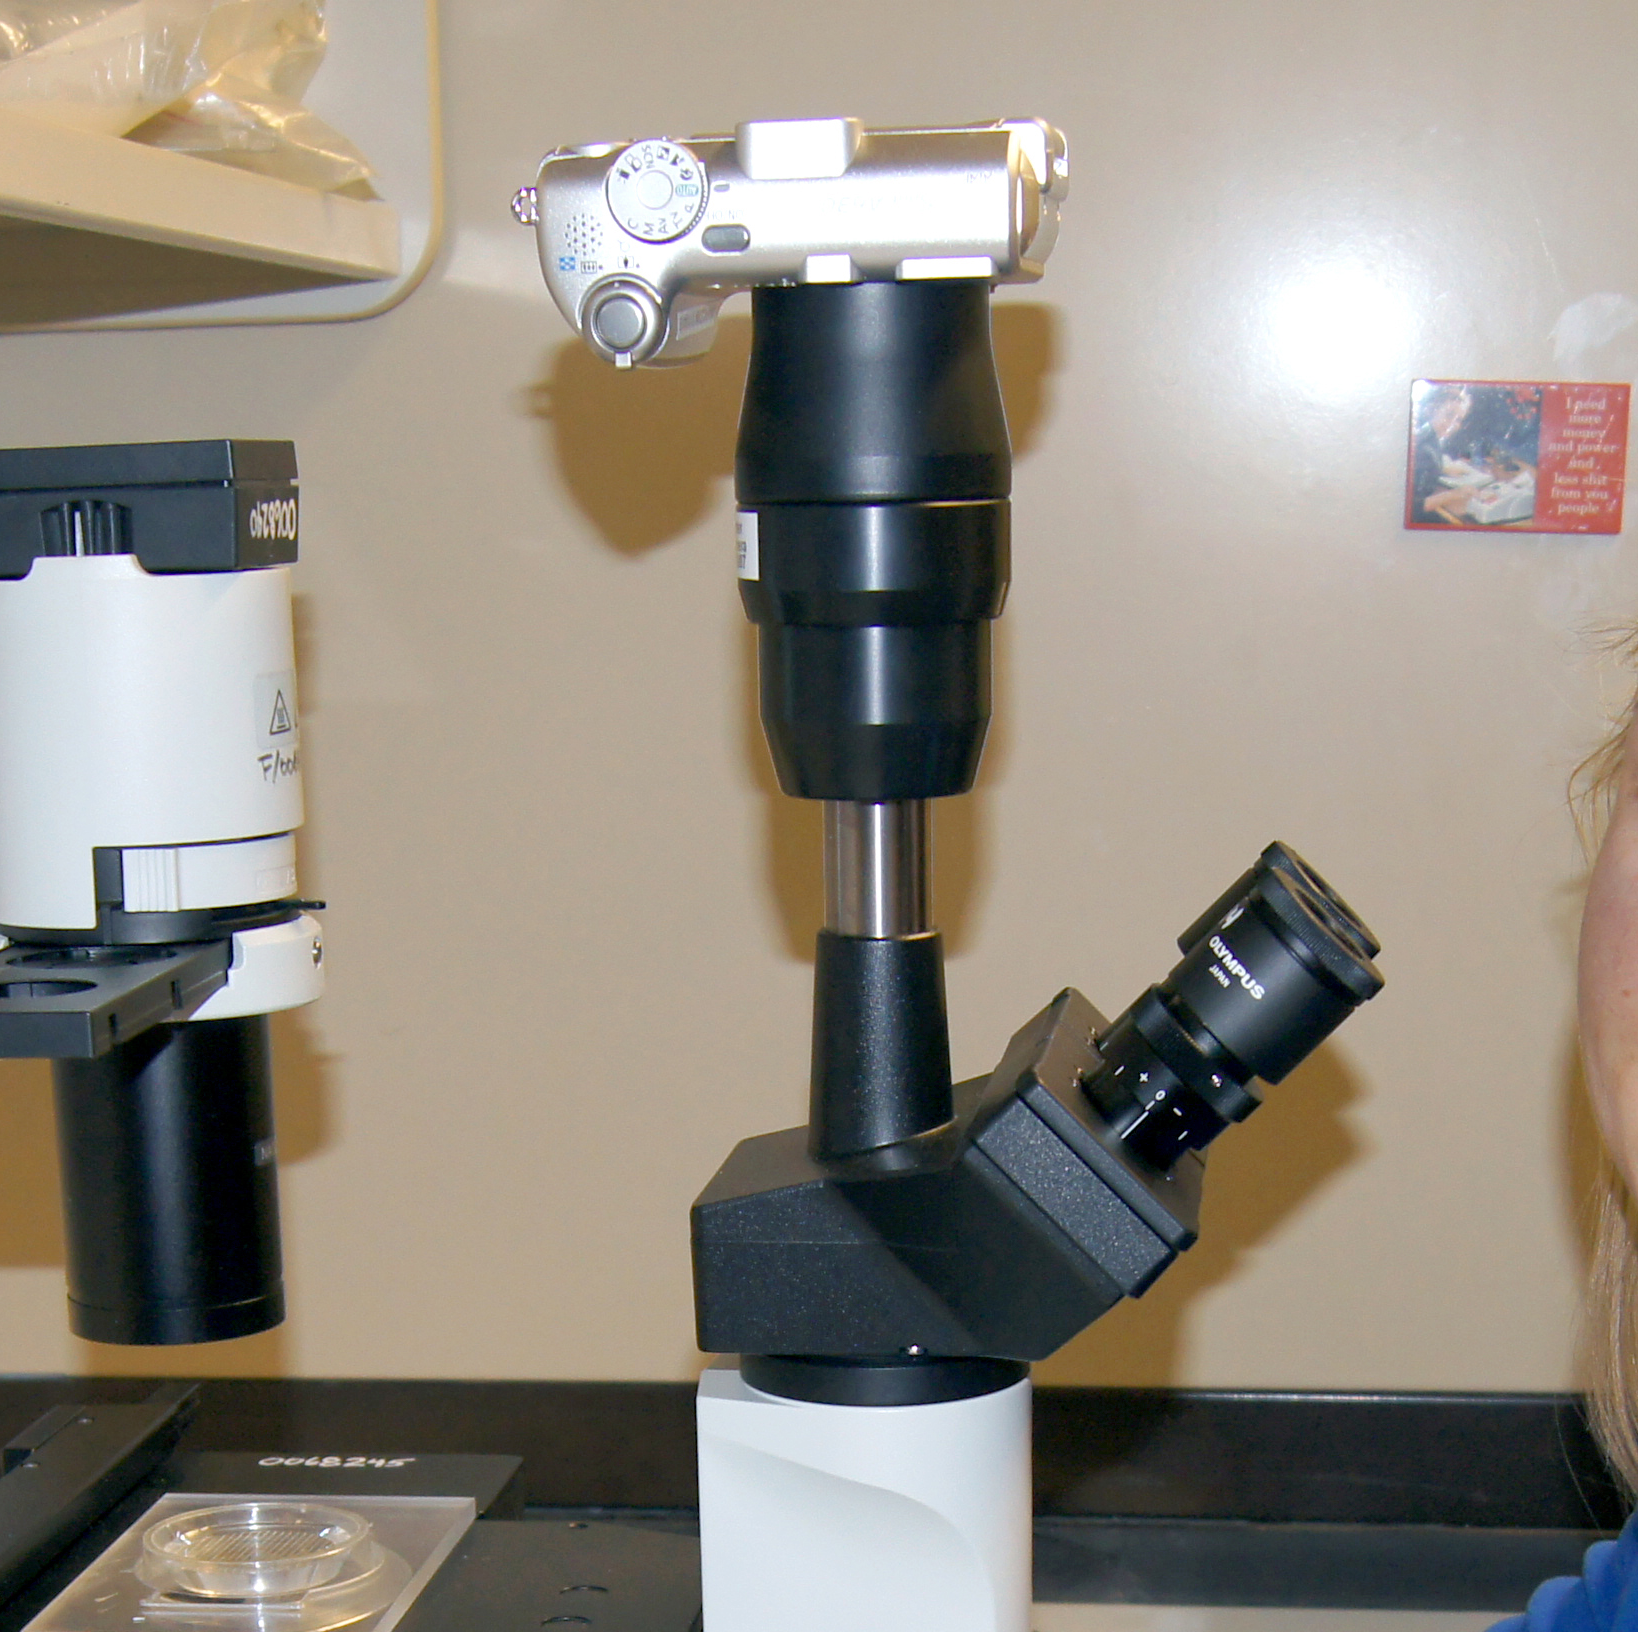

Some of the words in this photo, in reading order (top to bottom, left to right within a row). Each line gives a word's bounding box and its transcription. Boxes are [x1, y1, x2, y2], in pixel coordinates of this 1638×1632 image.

[1569, 413, 1601, 424] more
[1563, 427, 1606, 440] money
[1577, 443, 1617, 456] power
[1551, 487, 1581, 499] from
[1558, 501, 1599, 515] people
[1209, 935, 1265, 1000] OLYMPUS
[1208, 965, 1230, 989] JAPAN
[258, 1455, 417, 1469] 0068245
